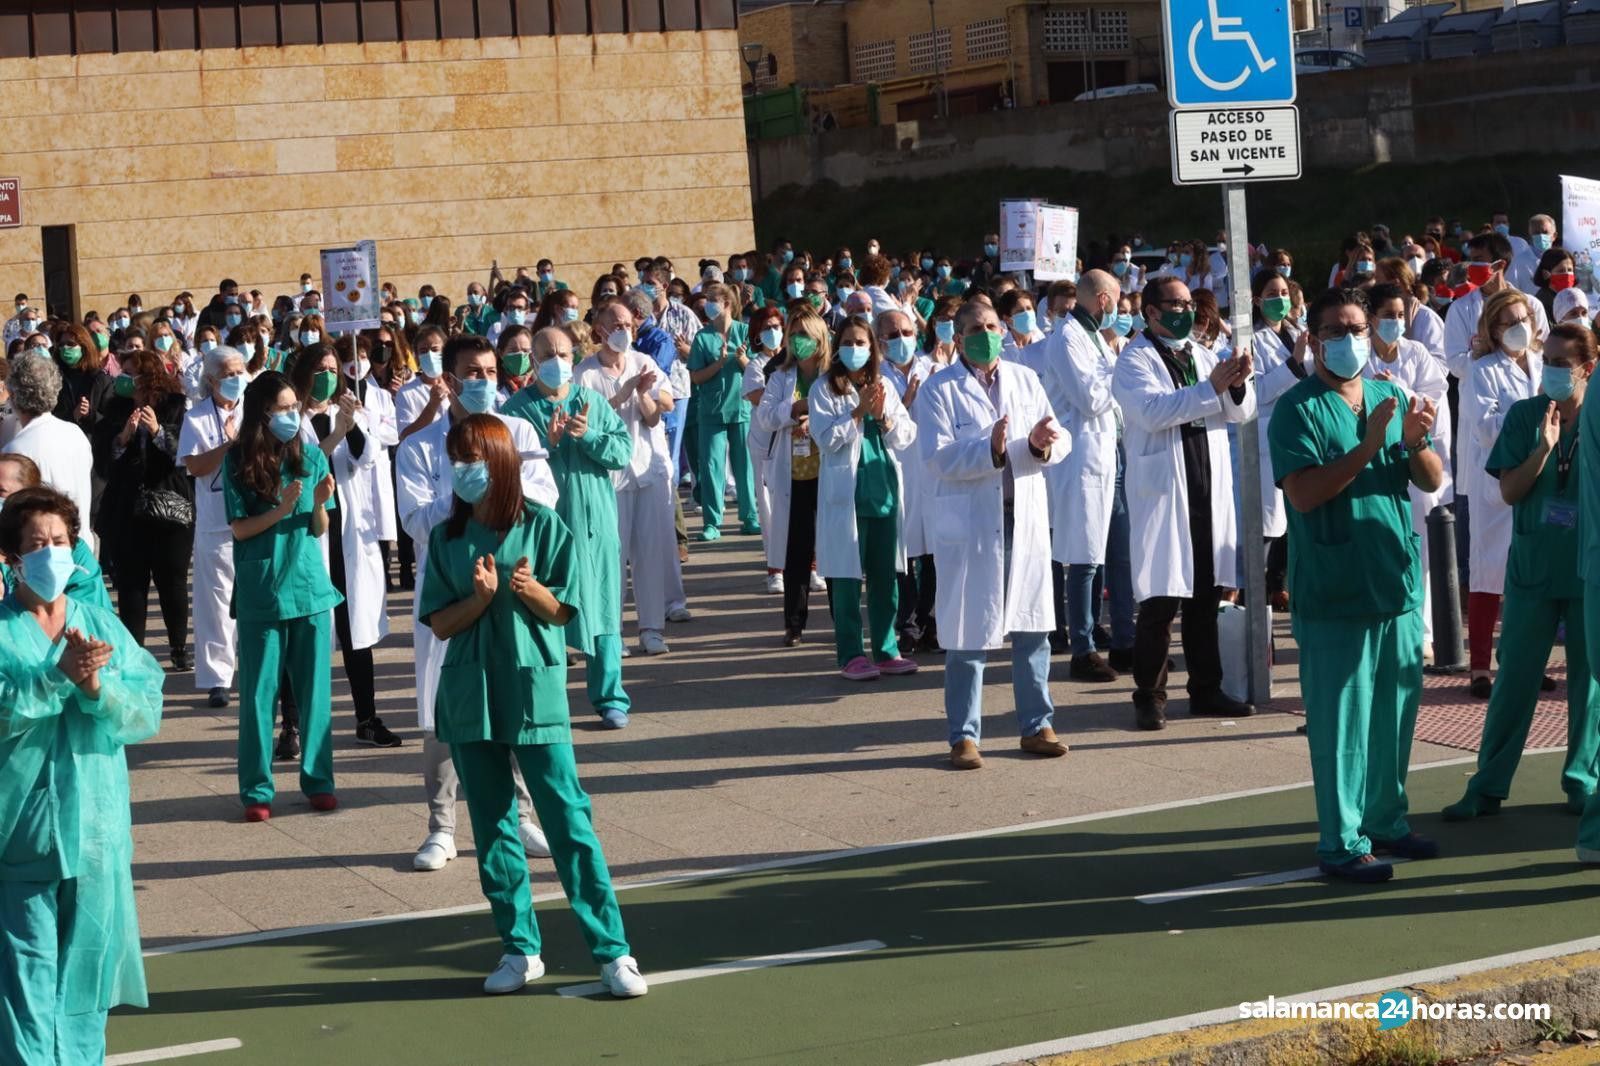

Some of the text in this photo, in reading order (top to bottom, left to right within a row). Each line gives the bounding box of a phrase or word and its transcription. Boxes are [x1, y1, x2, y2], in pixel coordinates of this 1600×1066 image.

[1347, 8, 1359, 26] P
[1207, 111, 1265, 125] ACCESO
[1201, 129, 1273, 143] PASEO DE
[1190, 146, 1286, 162] SAN VICENTE
